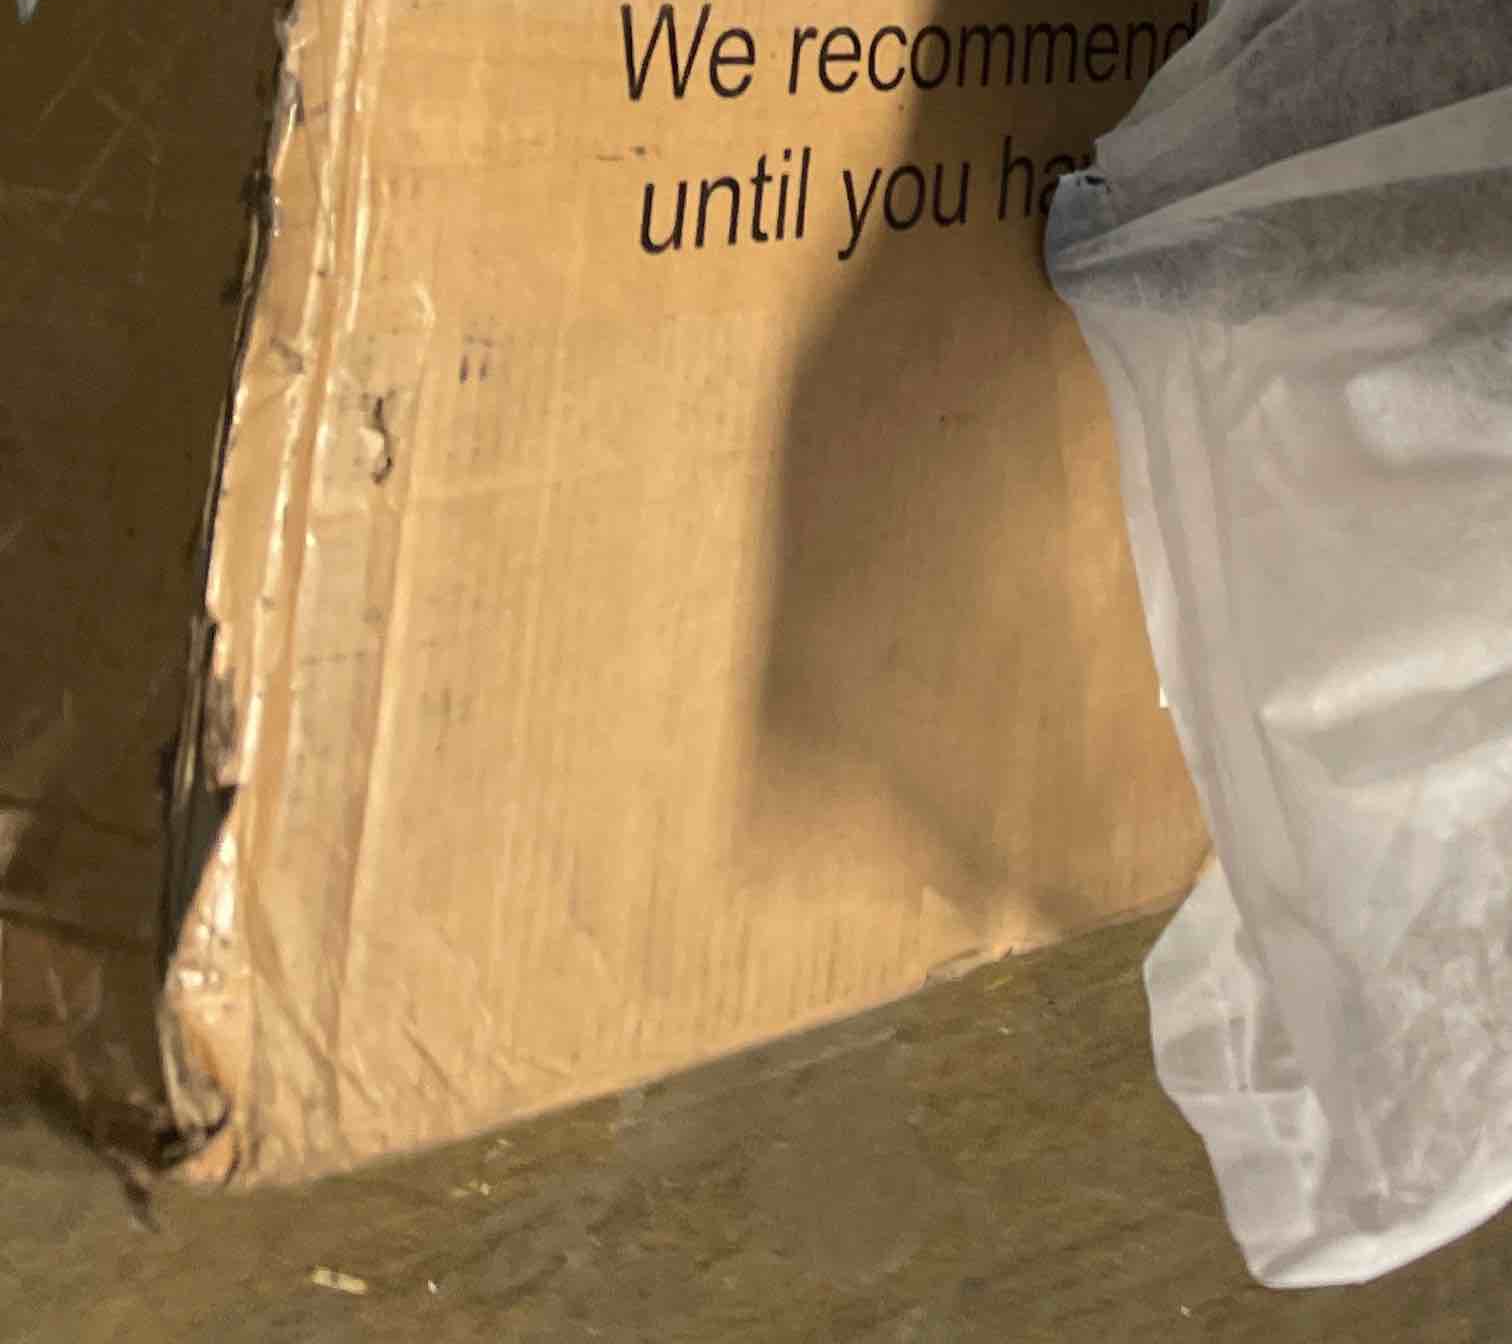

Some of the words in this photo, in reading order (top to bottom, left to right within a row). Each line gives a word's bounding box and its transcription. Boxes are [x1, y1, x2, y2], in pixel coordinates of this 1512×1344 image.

[619, 3, 756, 102] We
[638, 146, 812, 255] until
[837, 158, 971, 262] you
